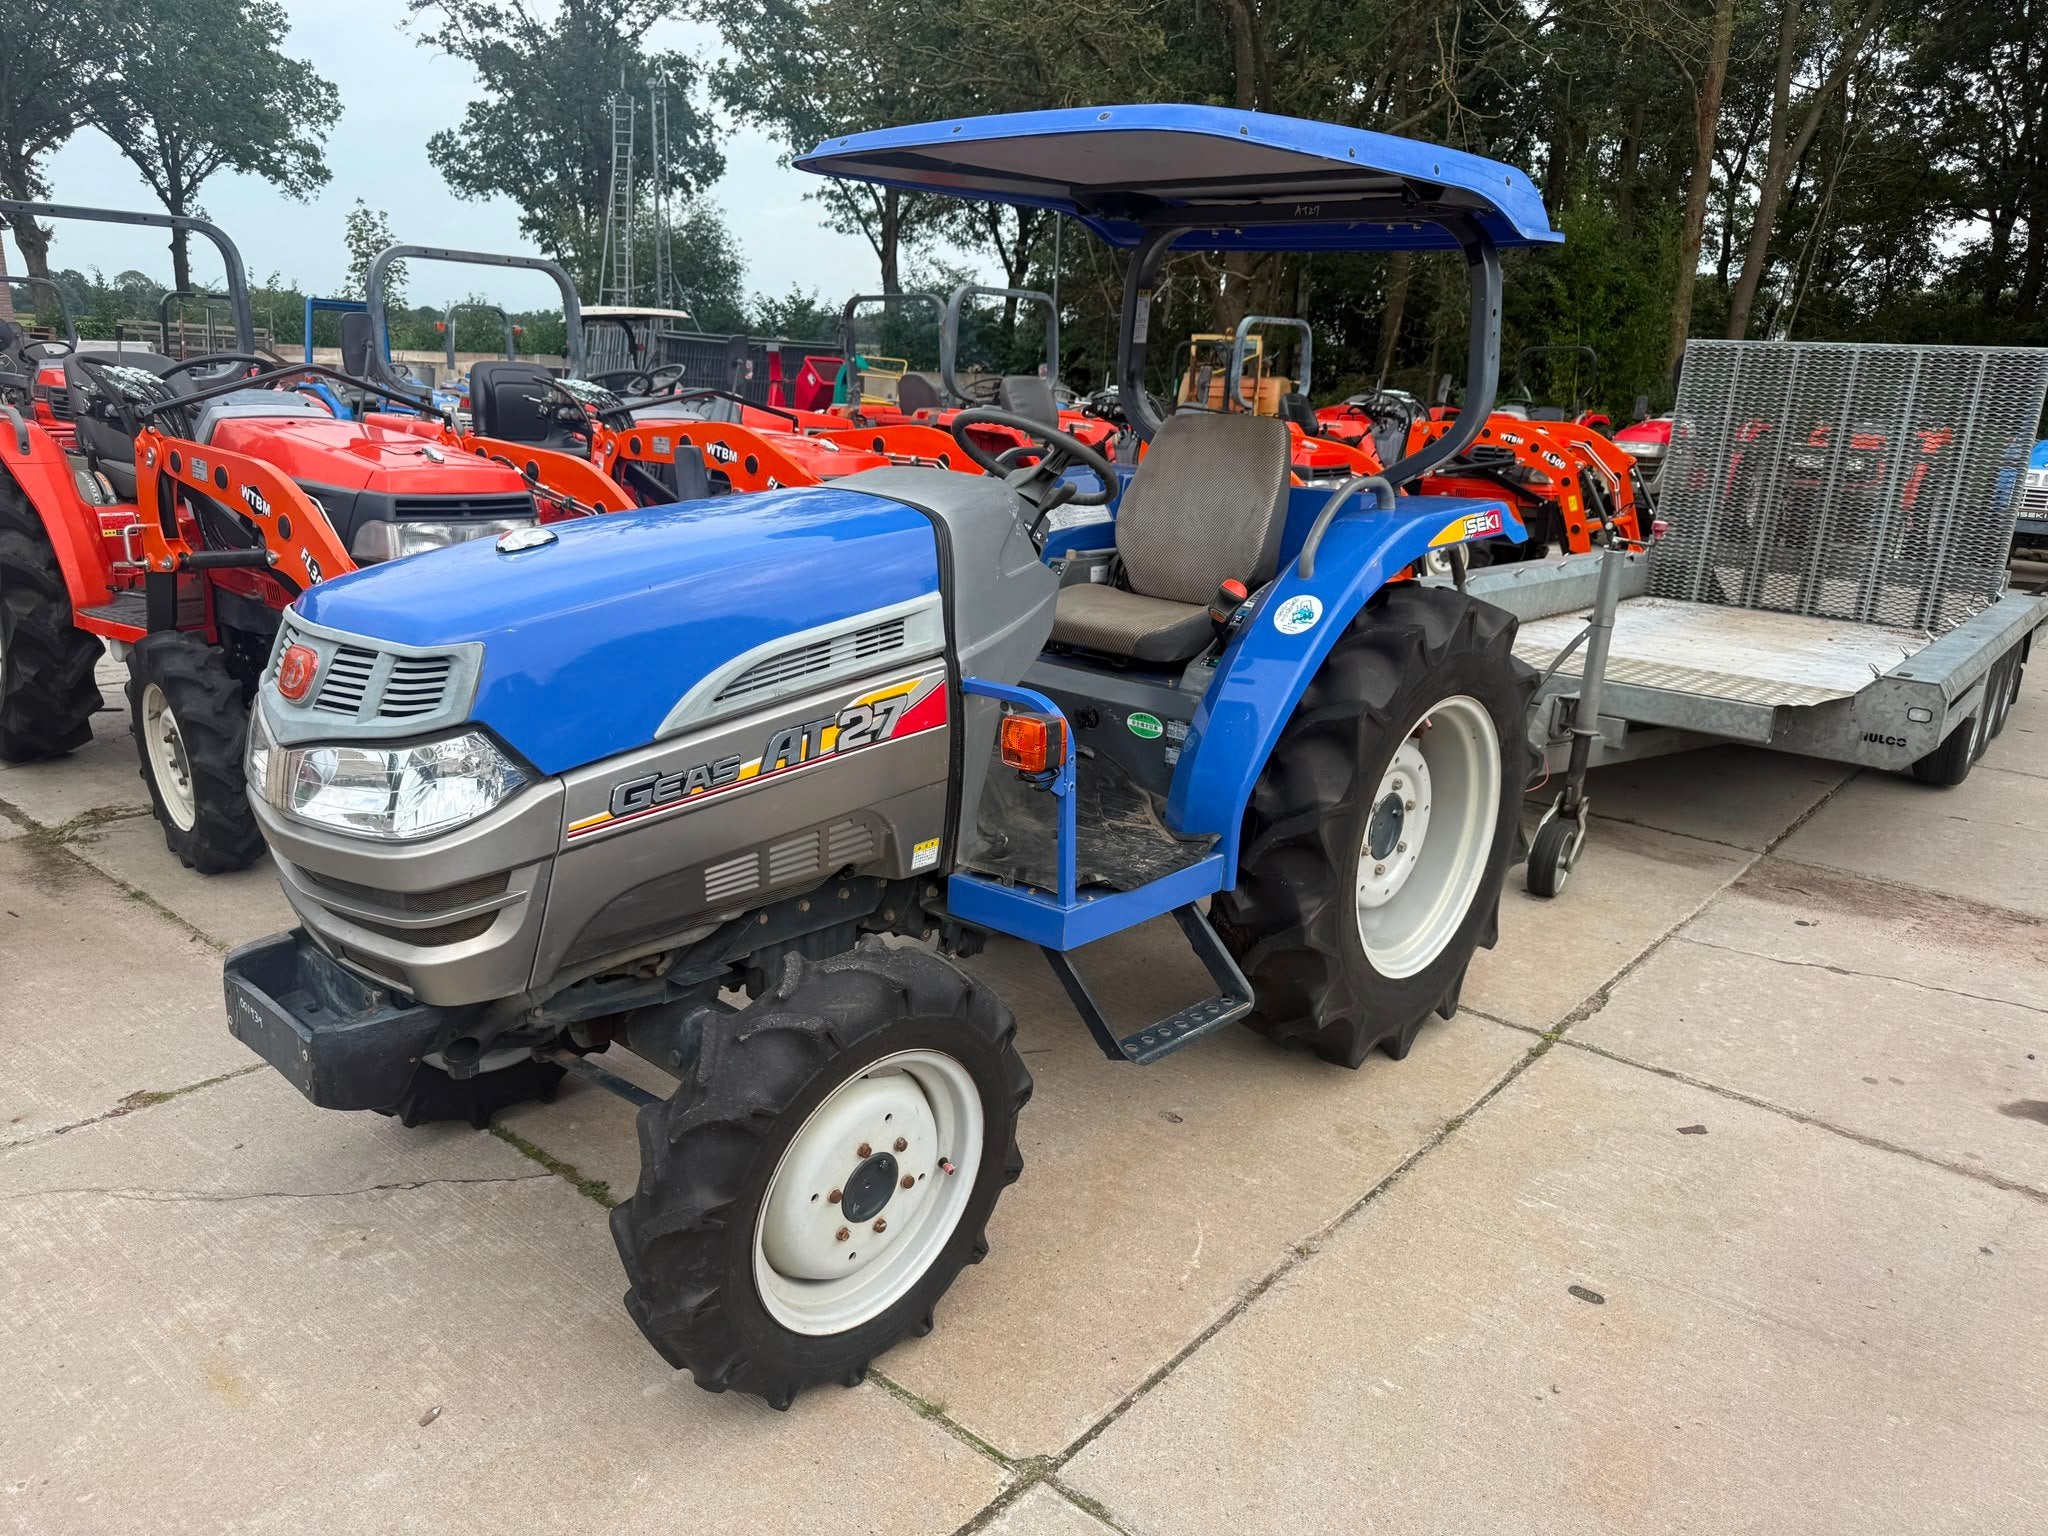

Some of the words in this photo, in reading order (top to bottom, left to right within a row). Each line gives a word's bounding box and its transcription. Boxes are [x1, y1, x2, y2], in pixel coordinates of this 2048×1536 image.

[1500, 433, 1524, 445] WTBM
[706, 442, 738, 463] WTBM
[1541, 450, 1566, 470] FL300
[241, 484, 271, 518] WTBM
[1463, 513, 1500, 535] ISEKI
[759, 692, 909, 775] AT27
